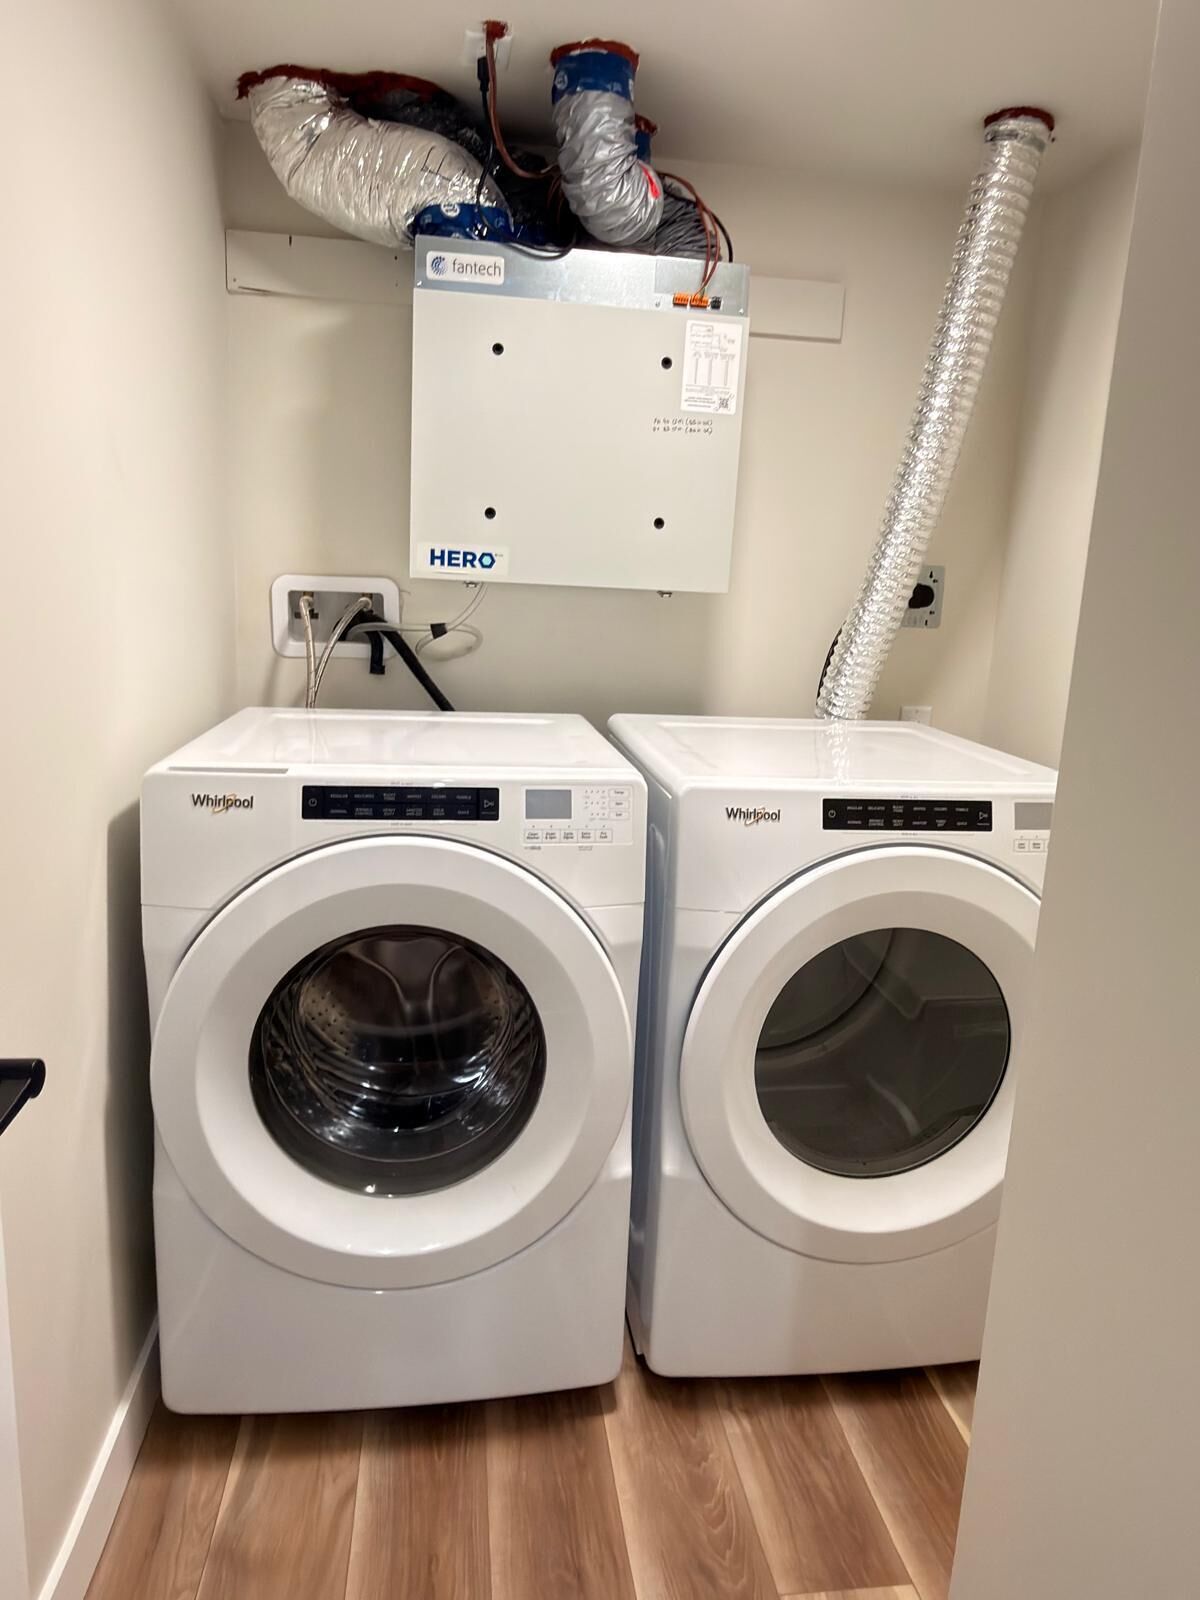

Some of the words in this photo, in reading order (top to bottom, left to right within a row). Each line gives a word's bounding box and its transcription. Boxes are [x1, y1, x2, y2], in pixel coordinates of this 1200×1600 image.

[452, 258, 502, 278] fantech
[430, 548, 496, 569] HERO
[191, 793, 254, 812] Whirlpool
[725, 807, 781, 826] Whirlpool
